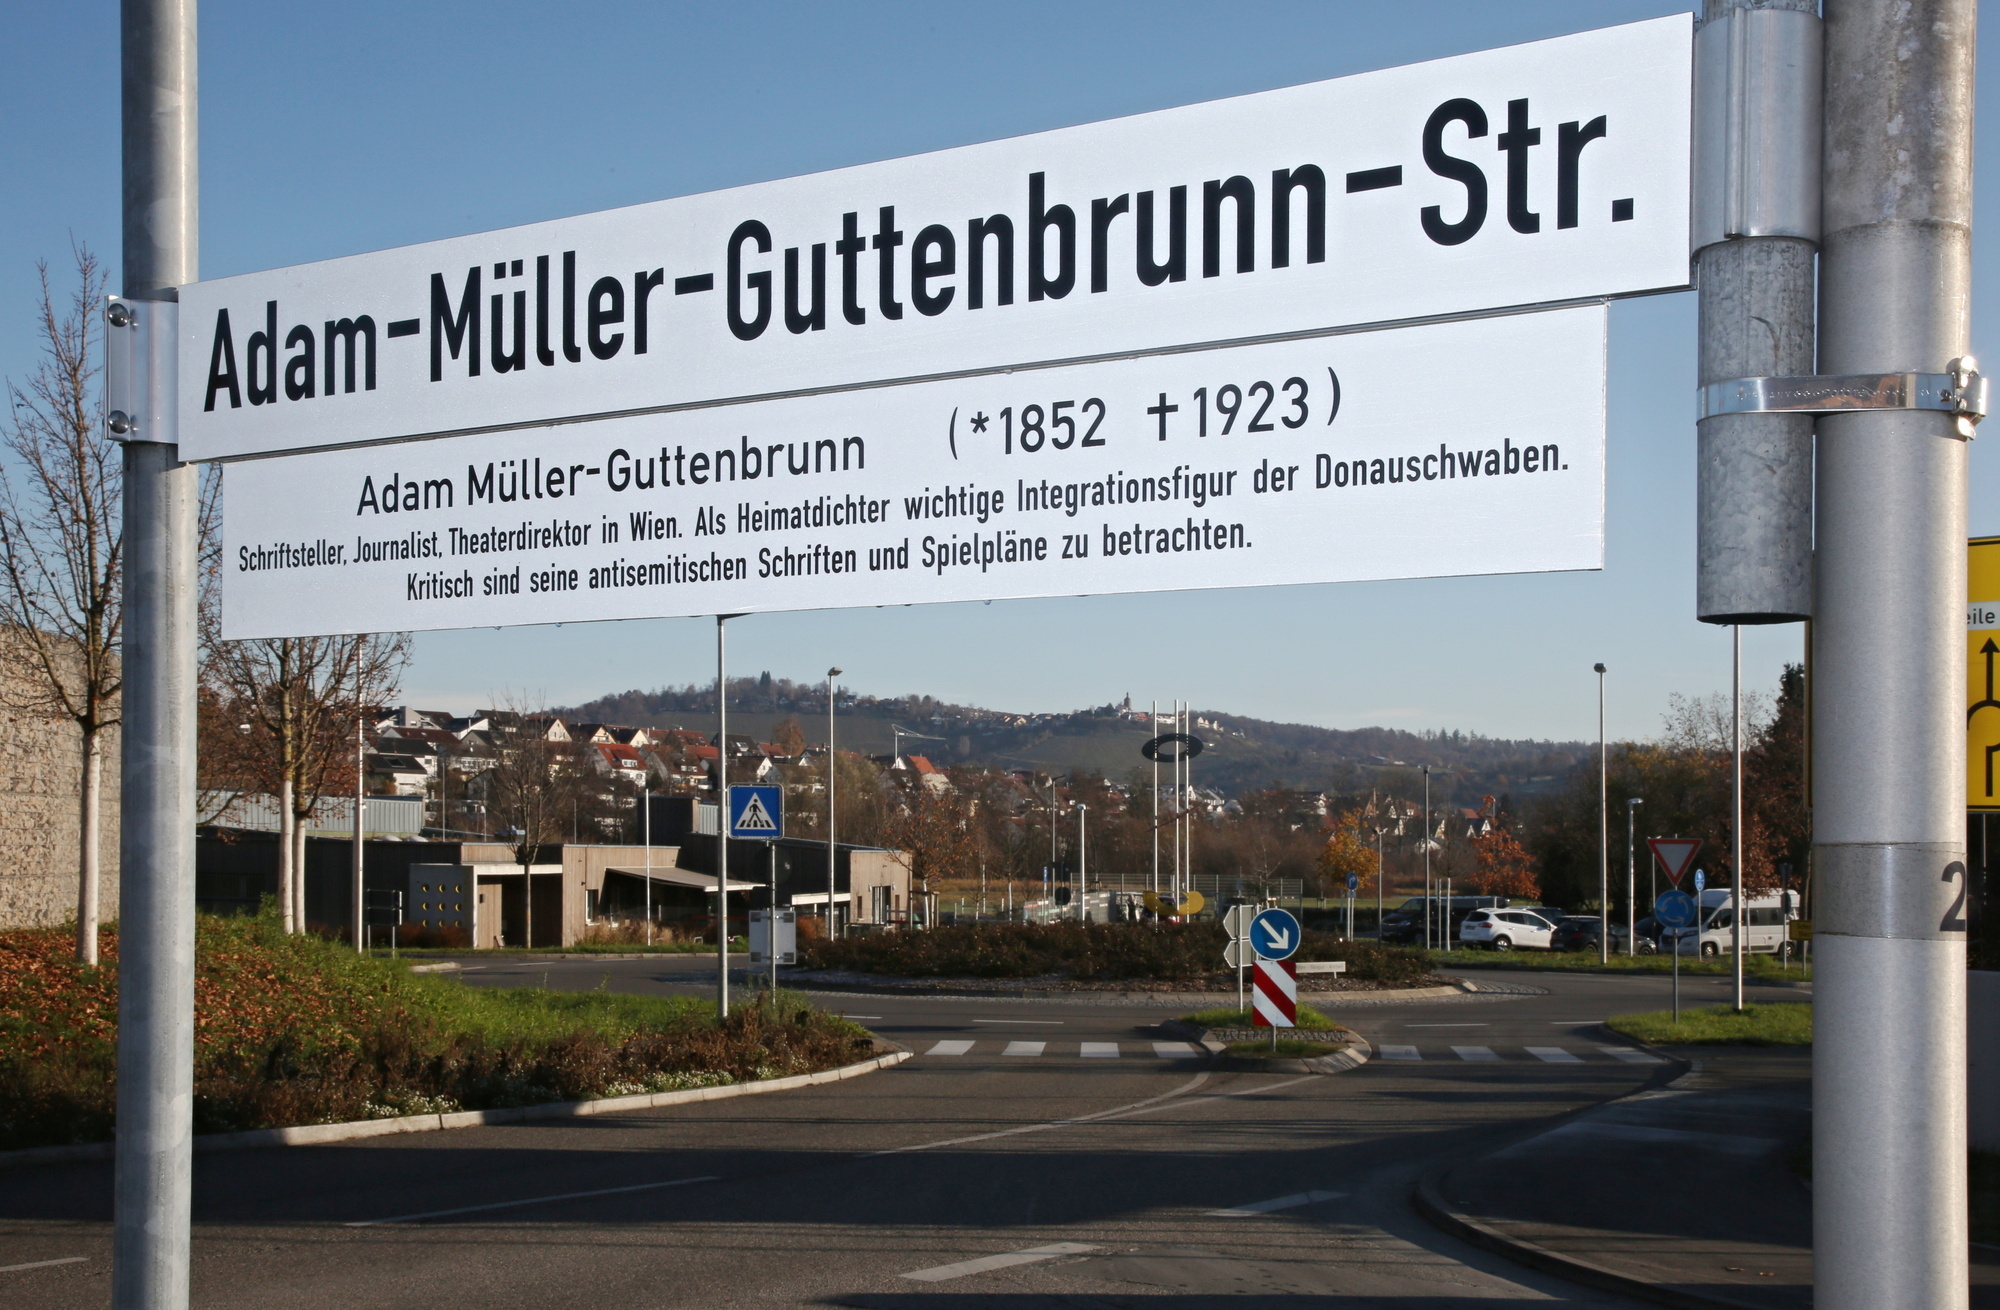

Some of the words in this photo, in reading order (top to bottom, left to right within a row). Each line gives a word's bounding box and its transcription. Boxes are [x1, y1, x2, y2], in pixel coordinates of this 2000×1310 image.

[203, 97, 1634, 413] Adam-Müller-Guttenbrunn-Str.
[239, 538, 347, 572] Schriftsteller,
[352, 530, 443, 564] Journalist,
[448, 519, 592, 556] Theaterdirektor
[602, 514, 619, 544] in
[629, 510, 683, 542] Wien.
[694, 505, 726, 537] Als
[737, 494, 891, 534] Heimatdichter
[904, 483, 1004, 524] wichtige
[1018, 464, 1238, 518] Integrationsfigur
[1253, 458, 1299, 494] der
[1316, 437, 1568, 489] Donauschwaben.
[356, 472, 453, 516] Adam
[468, 435, 865, 506] Müller-Guttenbrunn
[407, 569, 473, 601] Kritisch
[483, 565, 520, 596] sind
[529, 562, 578, 593] seine
[588, 551, 747, 590] antisemitischen
[758, 543, 857, 579] Schriften
[869, 537, 909, 572] und
[922, 530, 1047, 576] Spielpläne
[1061, 534, 1088, 559] zu
[1103, 517, 1252, 557] betrachten.
[1939, 860, 1967, 932] 2
